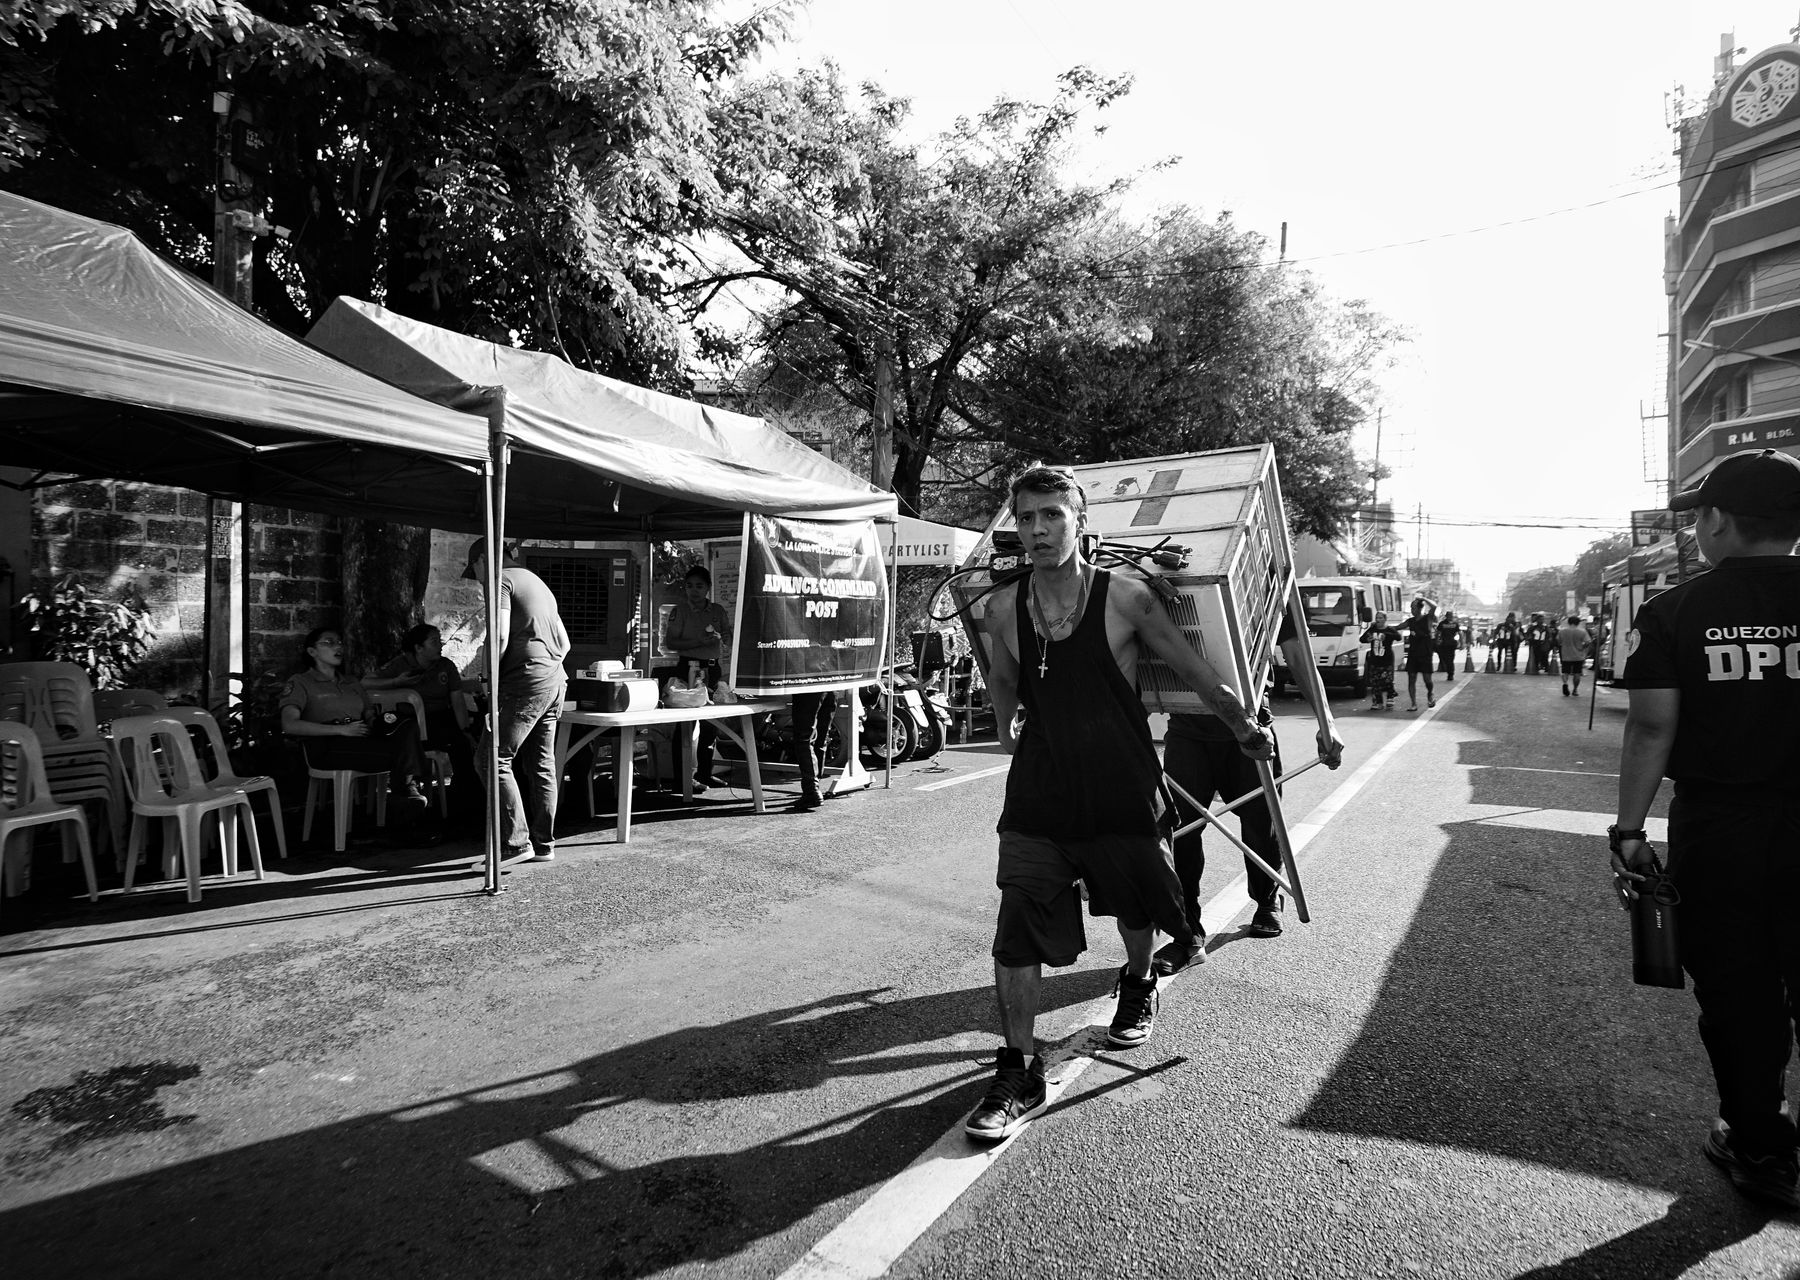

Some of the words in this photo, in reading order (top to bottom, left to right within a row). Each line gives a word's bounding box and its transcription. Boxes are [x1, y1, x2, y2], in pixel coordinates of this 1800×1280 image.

[1728, 431, 1757, 446] R.M.
[1766, 428, 1794, 440] BLDG.
[819, 578, 877, 597] COMMAND
[806, 601, 839, 618] POST
[1705, 625, 1797, 640] QUEZON
